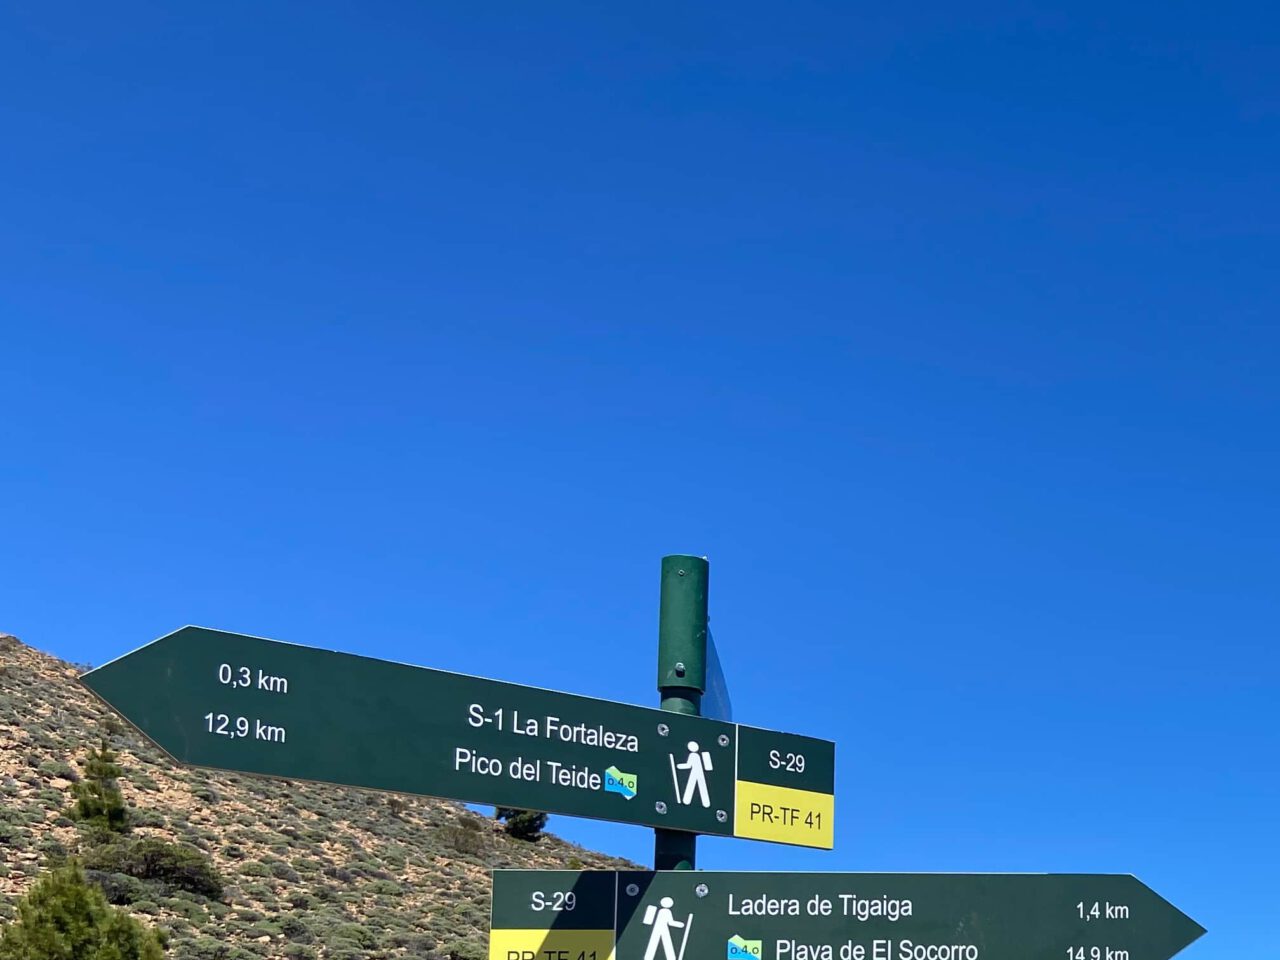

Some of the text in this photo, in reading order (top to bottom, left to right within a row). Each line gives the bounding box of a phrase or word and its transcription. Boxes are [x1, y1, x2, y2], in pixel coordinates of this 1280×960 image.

[218, 663, 288, 694] 0,3 km
[204, 712, 286, 743] 12,9 km
[468, 703, 639, 753] S-1 La Fortaleza
[455, 748, 601, 790] Pico del Teide
[769, 749, 805, 773] S-29
[750, 802, 821, 830] PR-TF 41
[531, 891, 577, 911] S-29
[728, 894, 913, 922] Ladera de Tigaiga
[1076, 901, 1129, 922] 1,4 km
